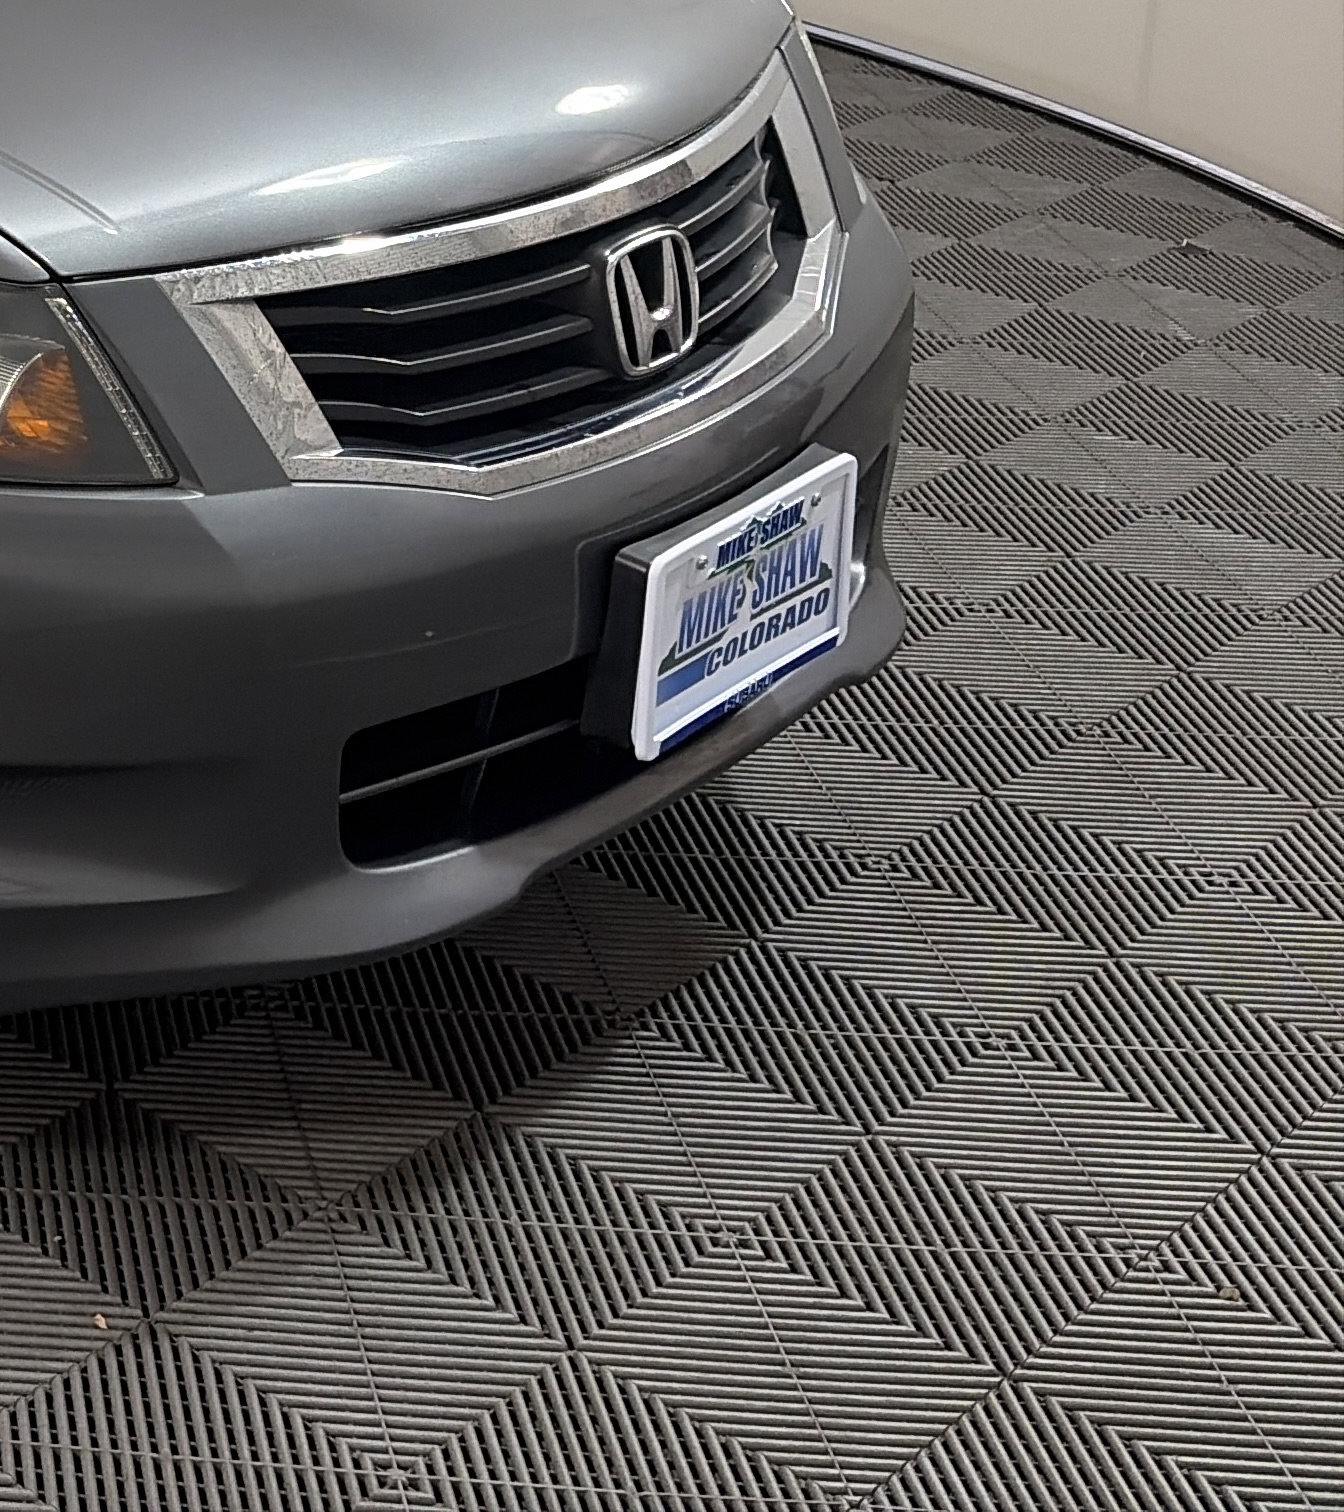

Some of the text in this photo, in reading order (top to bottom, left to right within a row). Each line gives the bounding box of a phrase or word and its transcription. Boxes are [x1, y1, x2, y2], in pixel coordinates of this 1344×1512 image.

[716, 498, 805, 570] MIKE SHAW
[677, 523, 825, 654] MIKE SHAW
[705, 587, 831, 678] COLORADO
